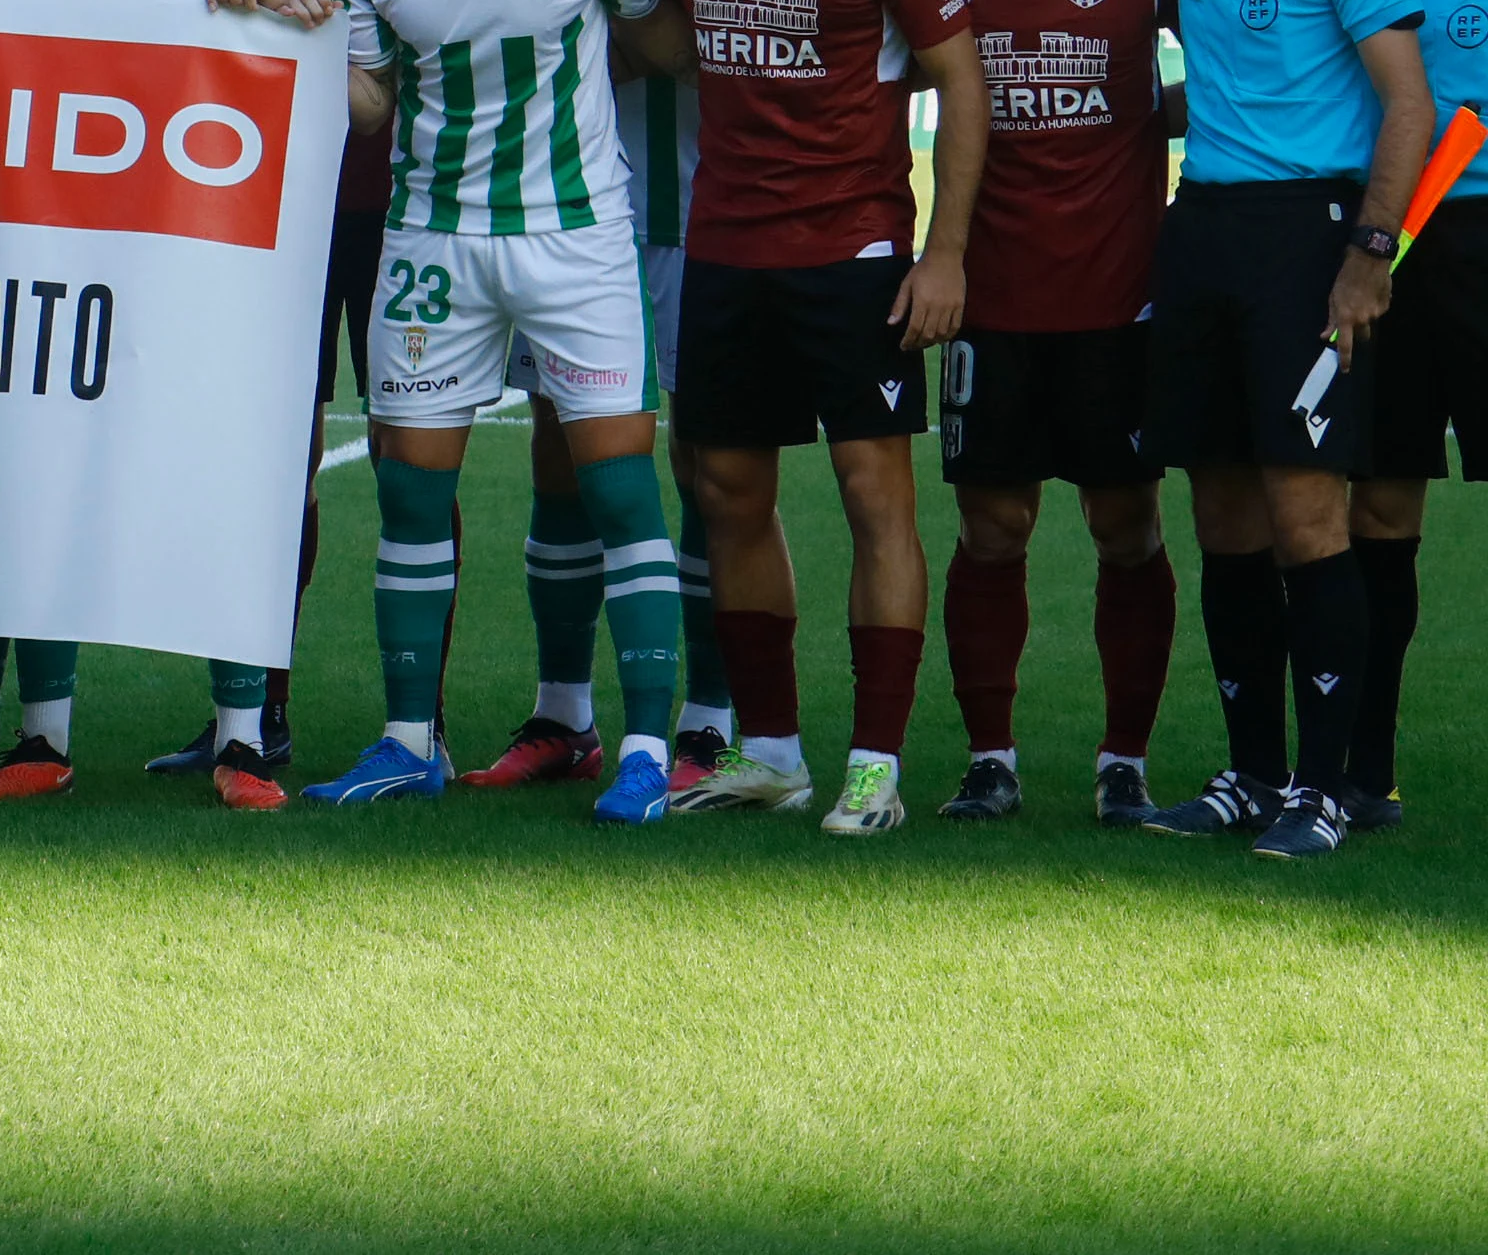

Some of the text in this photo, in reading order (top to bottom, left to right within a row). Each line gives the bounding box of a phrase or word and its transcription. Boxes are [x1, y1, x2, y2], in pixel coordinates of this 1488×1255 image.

[695, 27, 822, 67] MÉRIDA
[761, 67, 826, 79] HUMANIDAD
[990, 84, 1109, 118] ÉRIDA
[1017, 120, 1032, 131] DE
[1032, 119, 1046, 130] LA
[1047, 114, 1112, 129] HUMANIDAD
[383, 258, 452, 325] 23
[381, 376, 459, 394] GIVOVA
